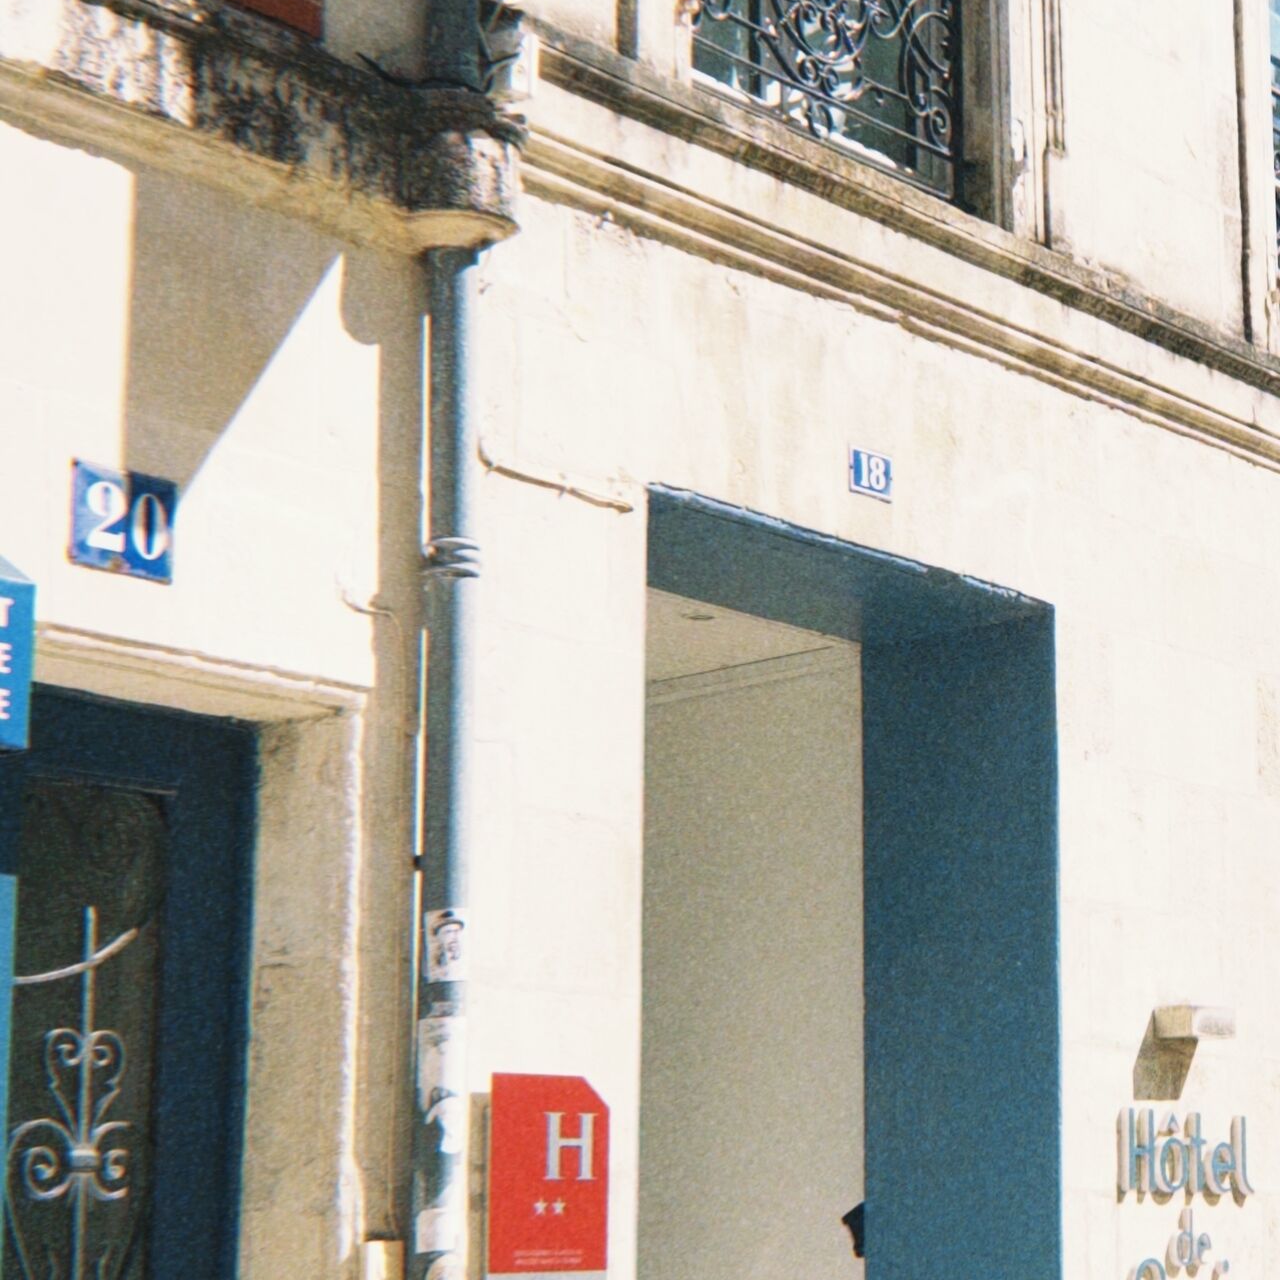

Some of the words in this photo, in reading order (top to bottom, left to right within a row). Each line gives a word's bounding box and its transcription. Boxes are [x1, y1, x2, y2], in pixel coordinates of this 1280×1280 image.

[860, 452, 886, 490] 18
[86, 481, 171, 560] 20
[541, 1111, 599, 1182] H
[1120, 1107, 1254, 1194] Hôtel
[1175, 1208, 1211, 1266] de
